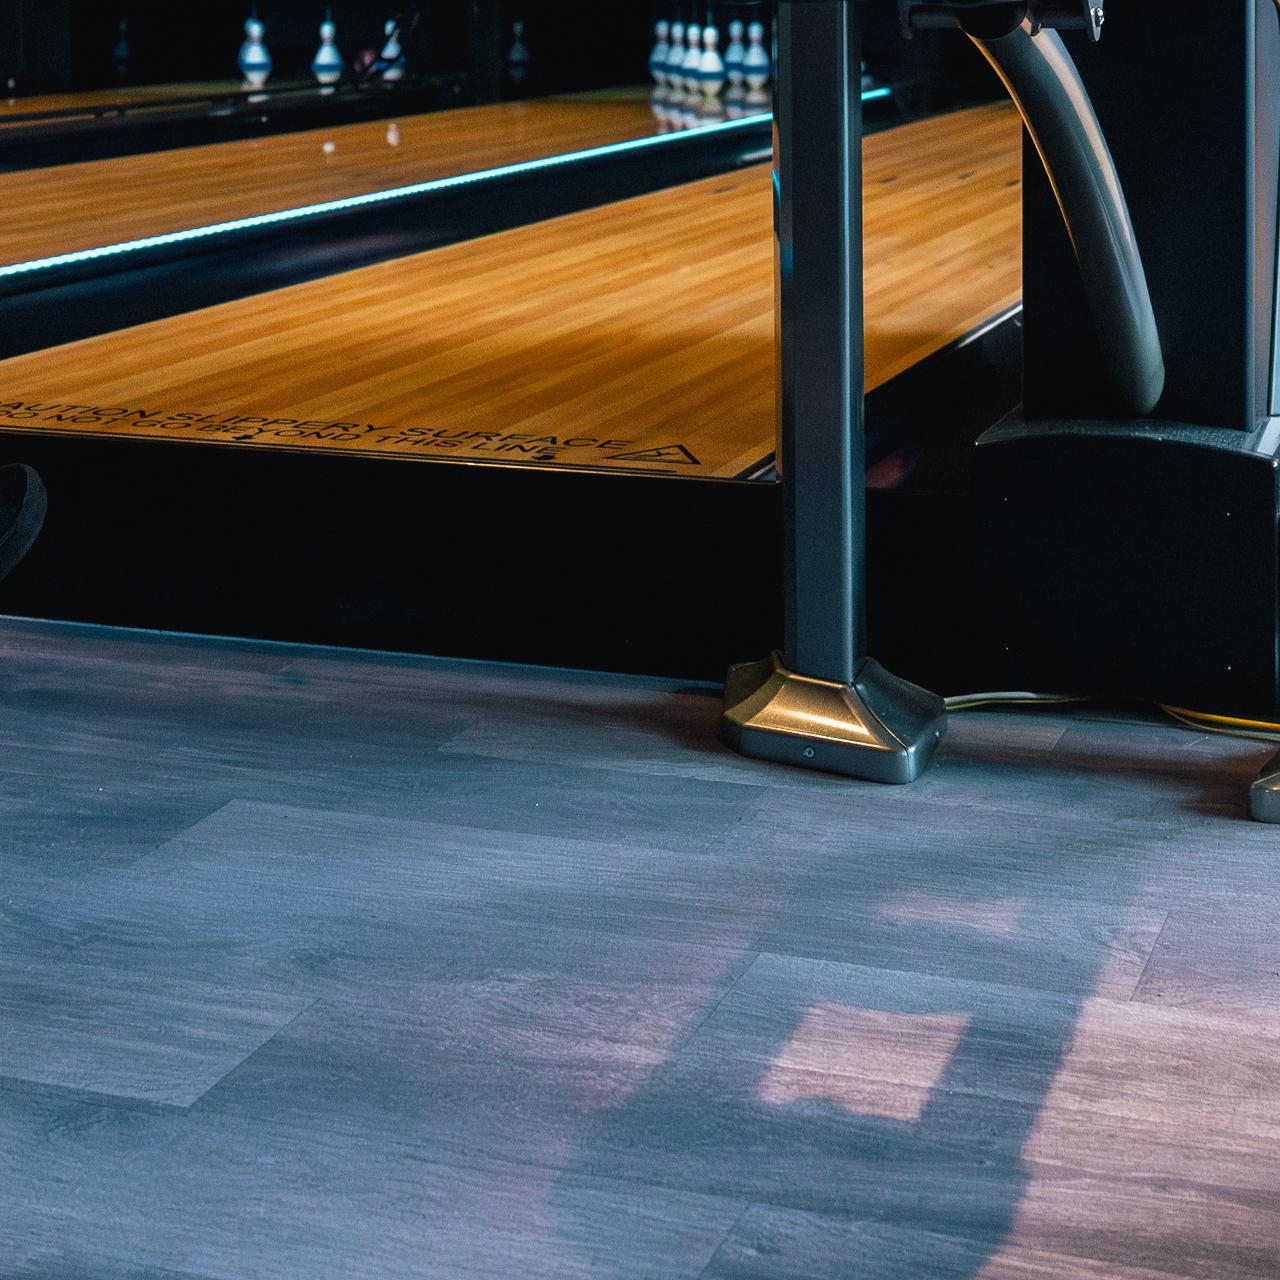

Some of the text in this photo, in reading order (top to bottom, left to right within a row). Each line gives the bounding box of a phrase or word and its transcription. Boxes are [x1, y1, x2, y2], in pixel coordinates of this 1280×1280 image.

[47, 413, 117, 425] NOT
[131, 420, 192, 431] GO
[196, 423, 361, 443] BEYOND
[374, 434, 468, 449] THIS
[472, 441, 570, 456] LINE
[170, 411, 392, 435] SLIPPERY
[400, 426, 634, 450] SURFACE
